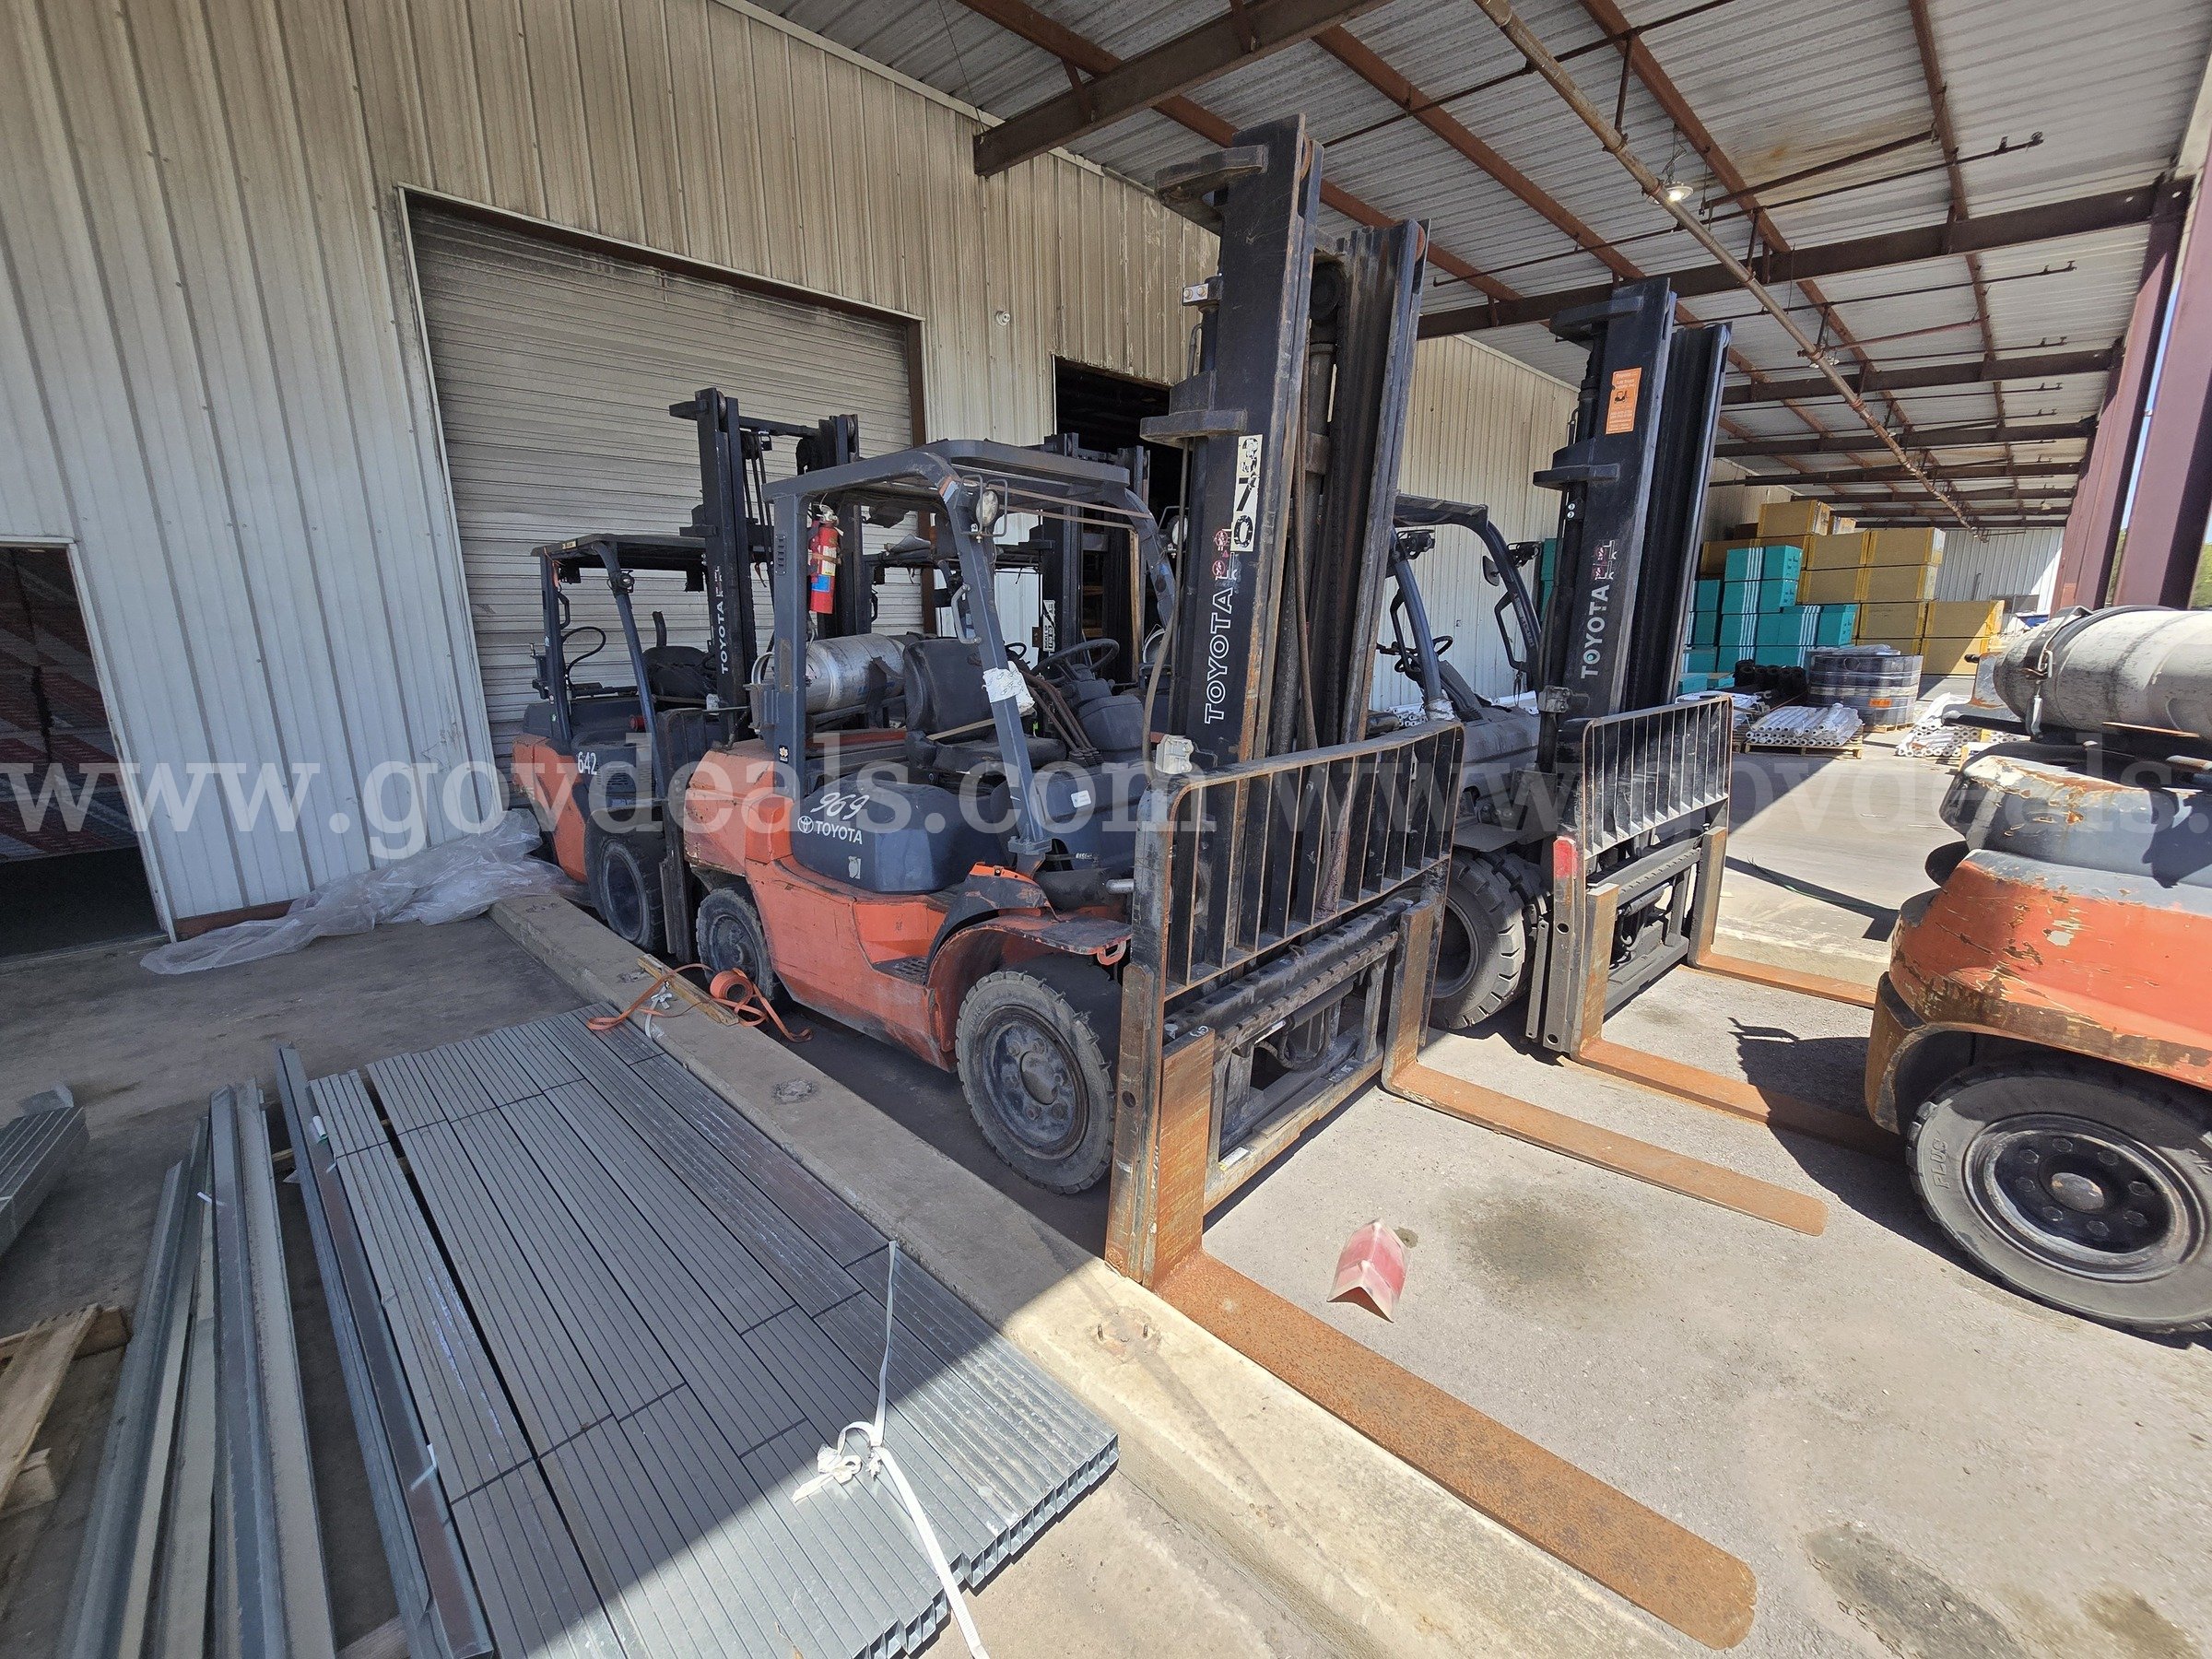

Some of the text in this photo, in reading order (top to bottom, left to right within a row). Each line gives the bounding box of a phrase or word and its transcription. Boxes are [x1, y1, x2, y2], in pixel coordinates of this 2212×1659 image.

[716, 601, 729, 675] TOYOTA
[1205, 586, 1234, 724] TOYOTA
[1580, 584, 1610, 679] TOYOTA
[577, 751, 597, 775] 642
[809, 792, 870, 820] 969
[815, 819, 863, 845] TOYOTA
